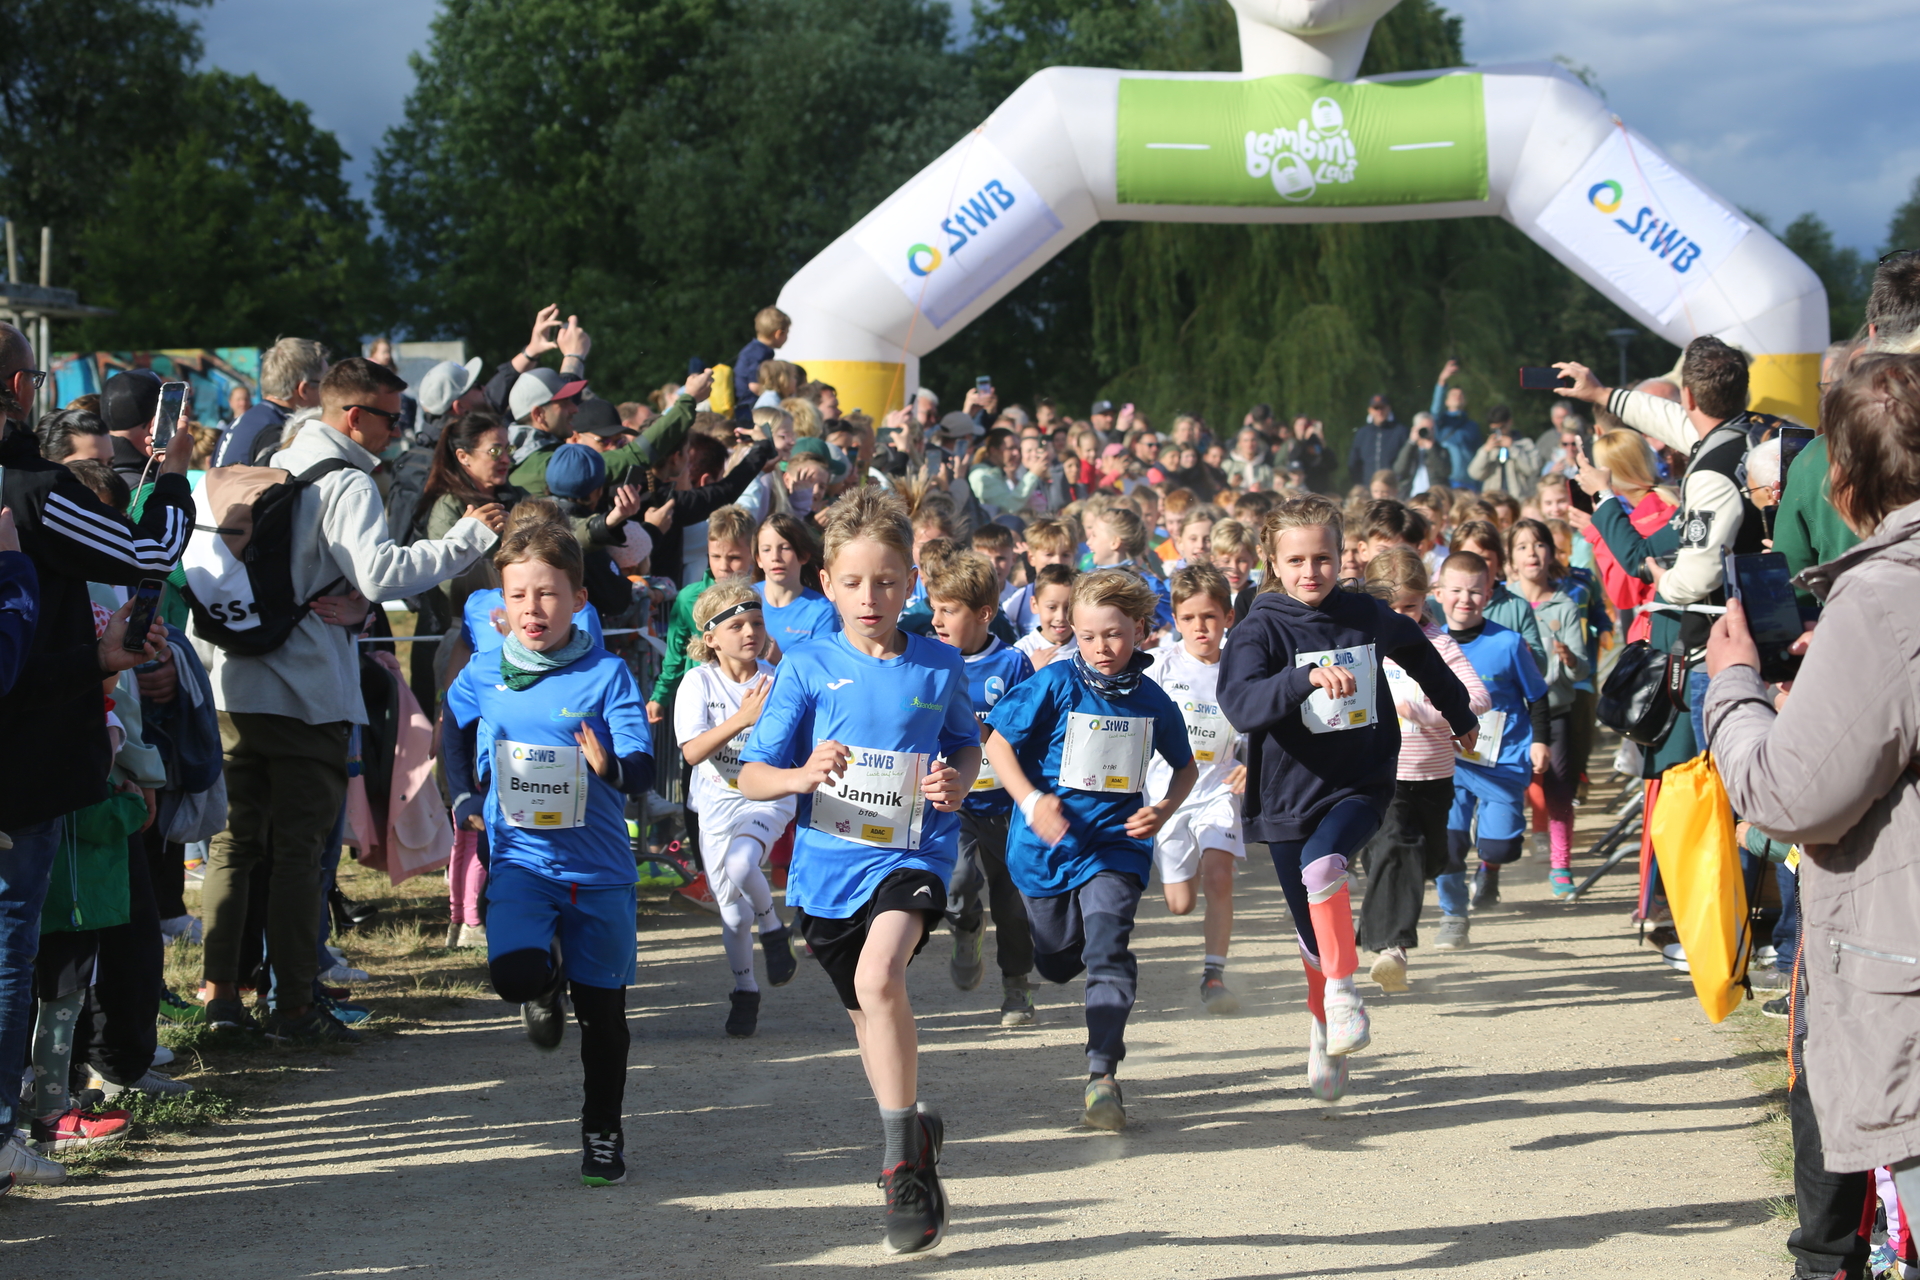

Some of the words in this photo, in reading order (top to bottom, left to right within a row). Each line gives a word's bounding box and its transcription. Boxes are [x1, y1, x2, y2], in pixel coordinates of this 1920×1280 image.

[941, 178, 1016, 257] StWB
[1613, 206, 1702, 275] StWB
[1334, 651, 1355, 666] StWB
[1671, 662, 1680, 690] Canon
[1171, 682, 1190, 691] JAKO
[707, 701, 726, 709] JAKO
[1194, 703, 1218, 715] StWB
[1101, 720, 1129, 732] StWB
[1187, 724, 1216, 739] Mica
[525, 749, 556, 763] StWB
[856, 753, 895, 770] StWB
[510, 776, 570, 795] Bennet
[837, 784, 904, 807] Jannik
[858, 808, 878, 818] b160
[870, 828, 886, 836] ADAC
